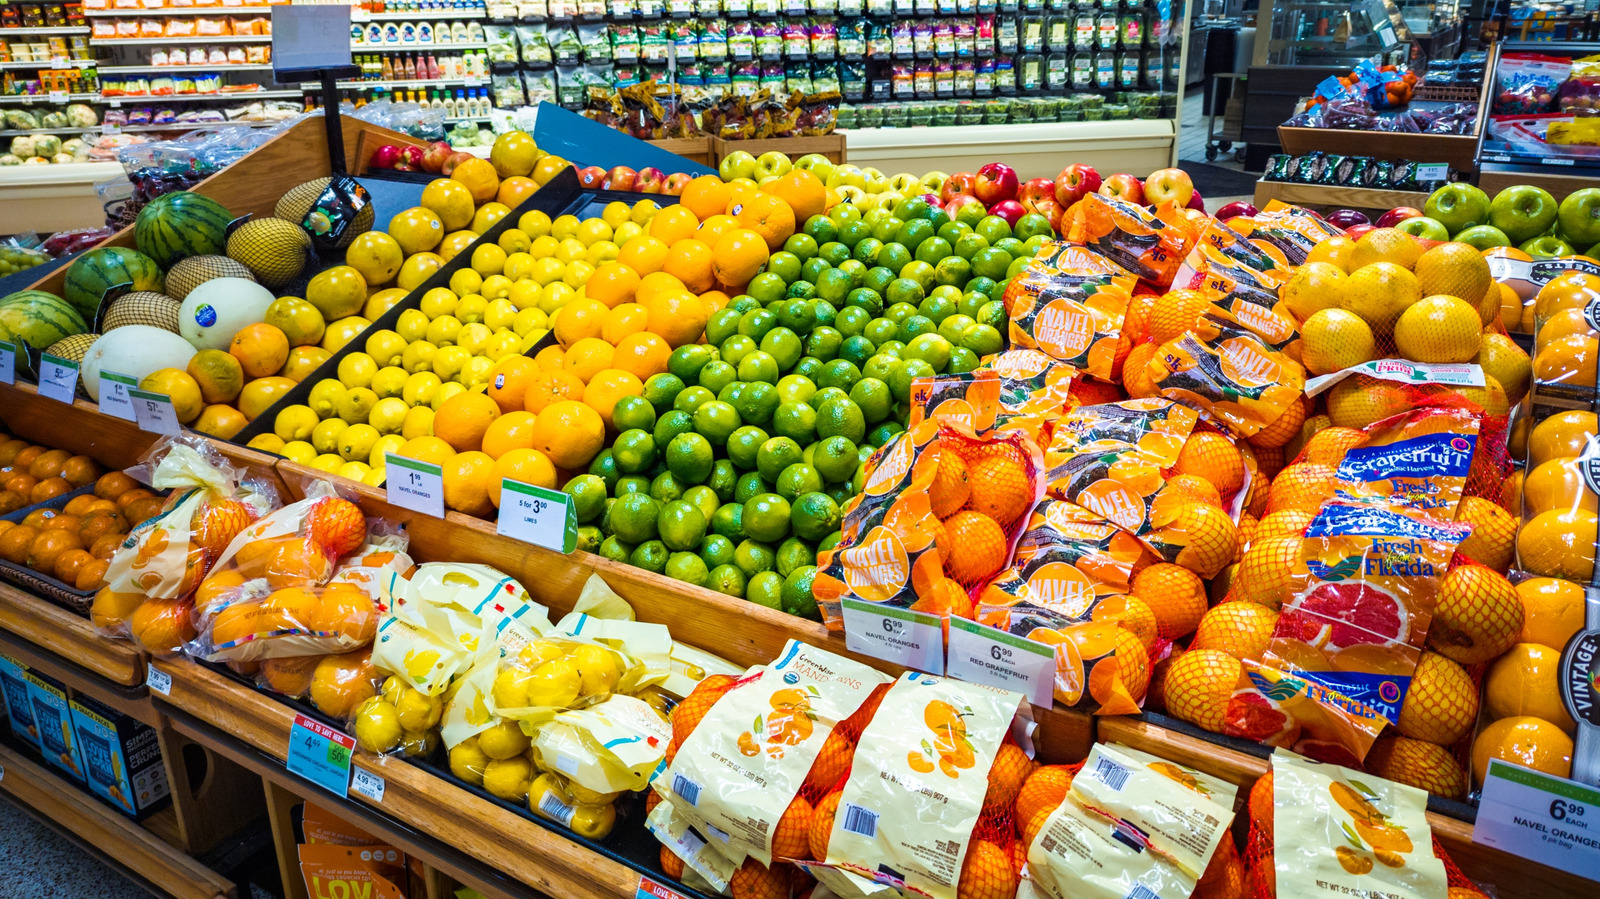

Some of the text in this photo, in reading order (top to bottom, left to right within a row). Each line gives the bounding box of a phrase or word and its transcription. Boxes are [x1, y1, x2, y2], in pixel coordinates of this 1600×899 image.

[1211, 233, 1226, 248] sk
[1211, 280, 1228, 293] sk
[1044, 307, 1090, 335] NAVEL
[1038, 326, 1087, 351] ORANGES
[1164, 353, 1182, 372] sk
[1228, 340, 1277, 379] NAVEL
[914, 389, 927, 402] sk
[1392, 479, 1440, 495] Fresh
[519, 499, 523, 507] 5
[523, 500, 532, 508] for
[523, 516, 538, 525] LIMES
[846, 537, 899, 567] NAVEL
[1371, 537, 1423, 554] Fresh
[1365, 557, 1435, 577] Florida
[1385, 548, 1412, 570] from
[851, 563, 905, 588] ORANGES
[1030, 578, 1084, 605] NAVEL
[865, 631, 920, 650] NAVEL ORANGES
[969, 656, 1030, 682] RED GRAPEFRUIT
[1001, 658, 1016, 667] EACH
[1572, 640, 1599, 711] VINTAGE
[37, 709, 61, 729] LOVE
[303, 719, 344, 745] LOVE TO SAVE HERE.
[85, 739, 110, 764] LOVE
[334, 744, 346, 754] SAVE
[130, 750, 161, 769] CRUNC
[711, 751, 720, 760] NET
[720, 755, 727, 764] WT
[754, 775, 763, 786] 907
[933, 790, 944, 802] 907
[943, 796, 949, 804] g
[1513, 816, 1549, 834] NAVEL
[1565, 817, 1588, 829] EACH
[1548, 836, 1557, 844] pk
[1558, 839, 1574, 850] bag
[653, 885, 669, 898] LOVE
[1316, 879, 1328, 889] NET
[1329, 882, 1340, 892] WT
[1341, 886, 1350, 894] 32
